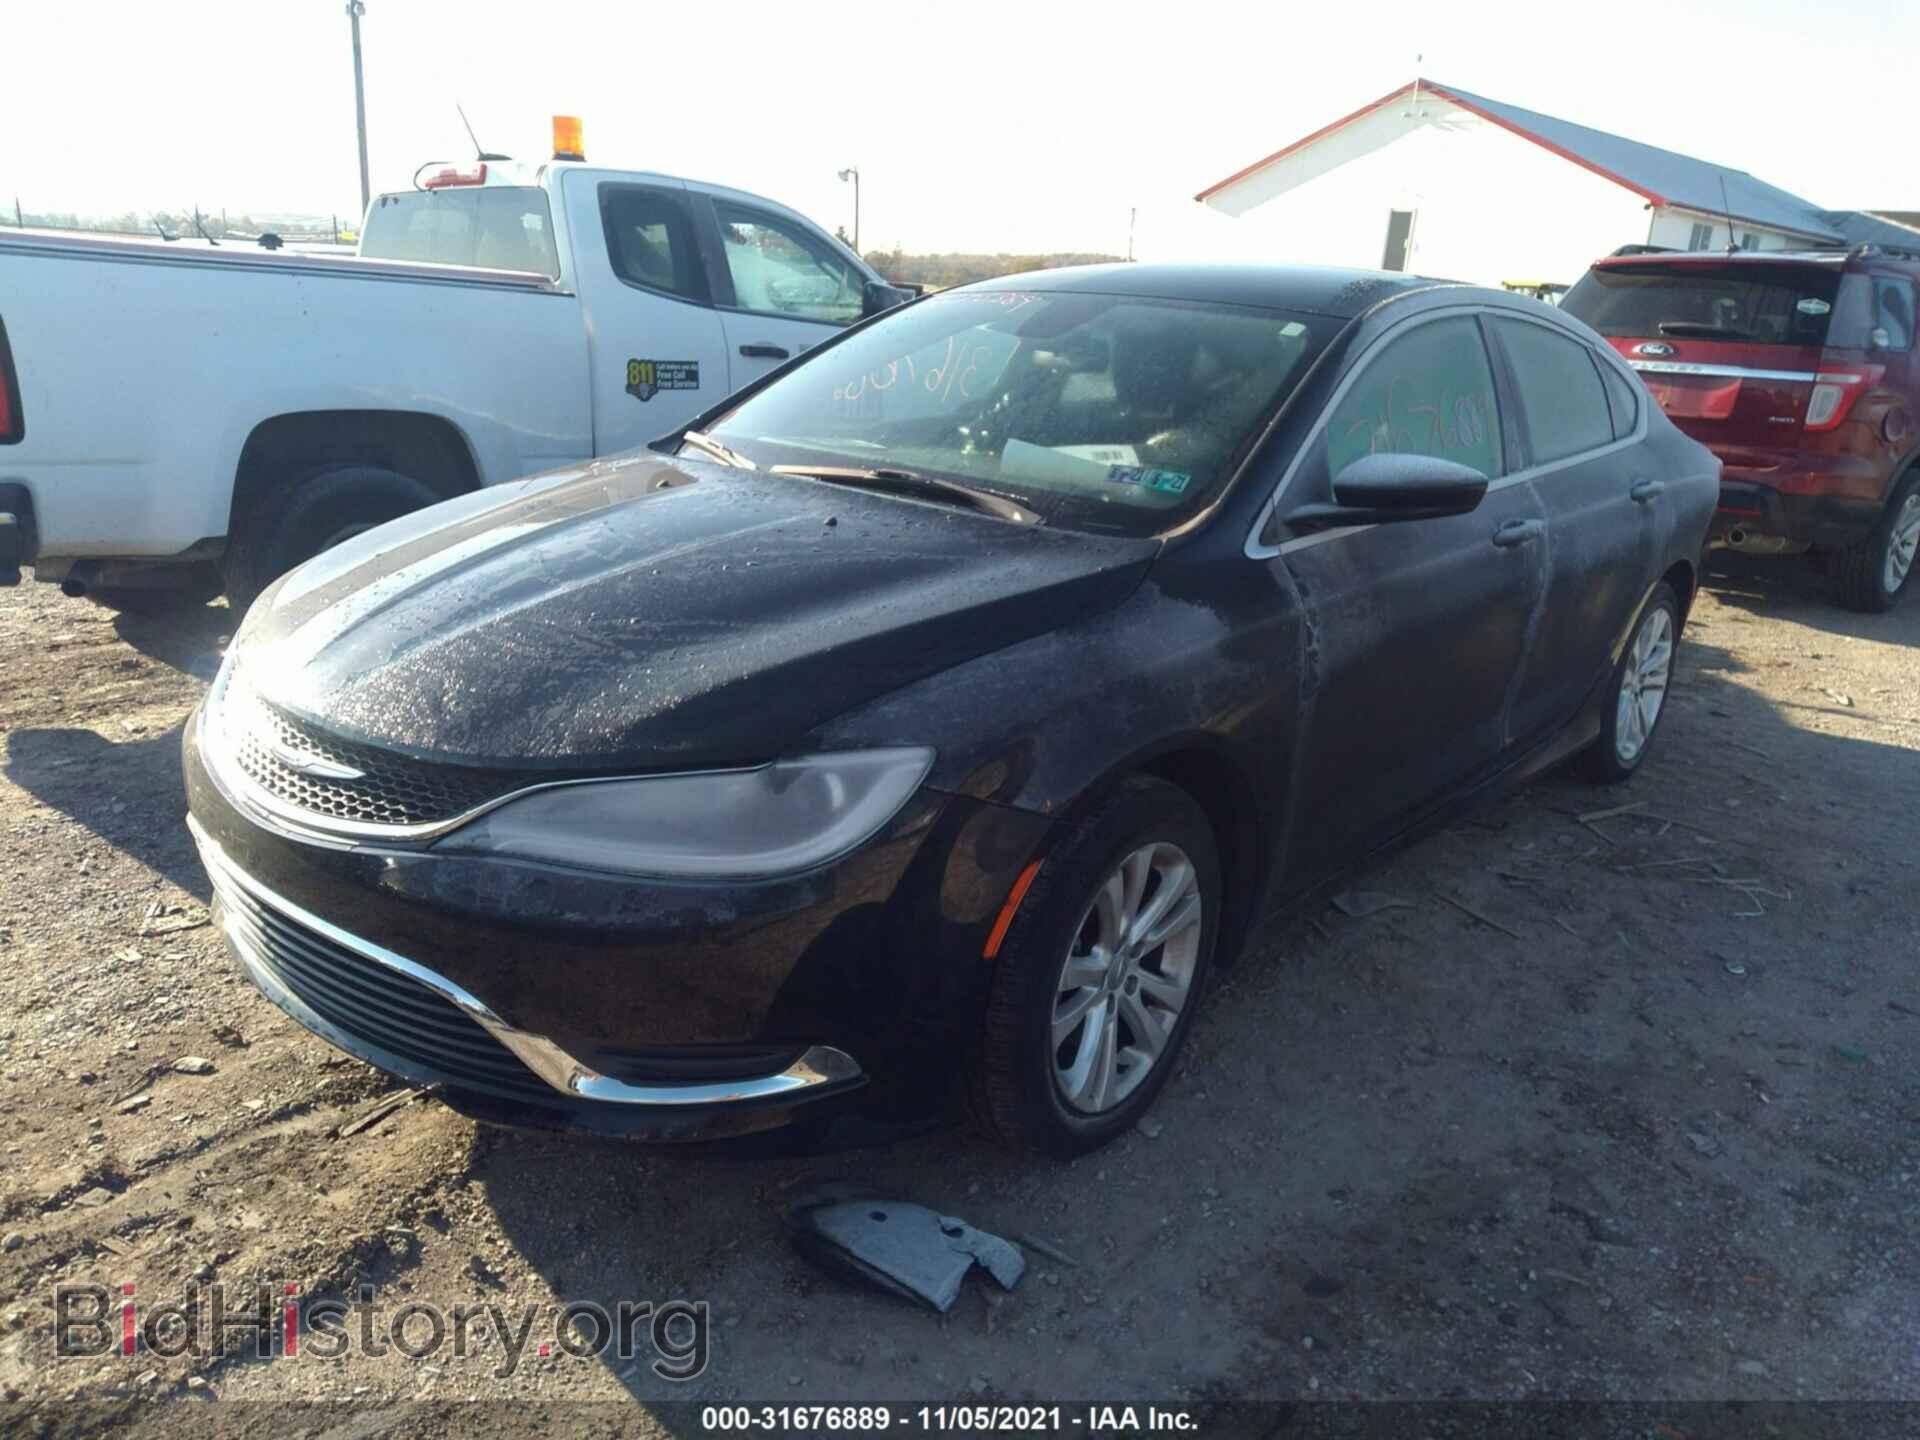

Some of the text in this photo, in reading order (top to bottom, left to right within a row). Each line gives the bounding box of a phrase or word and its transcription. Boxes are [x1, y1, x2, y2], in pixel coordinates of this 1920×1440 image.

[628, 361, 654, 385] 811
[656, 370, 687, 379] Free Call
[656, 380, 672, 388] Free
